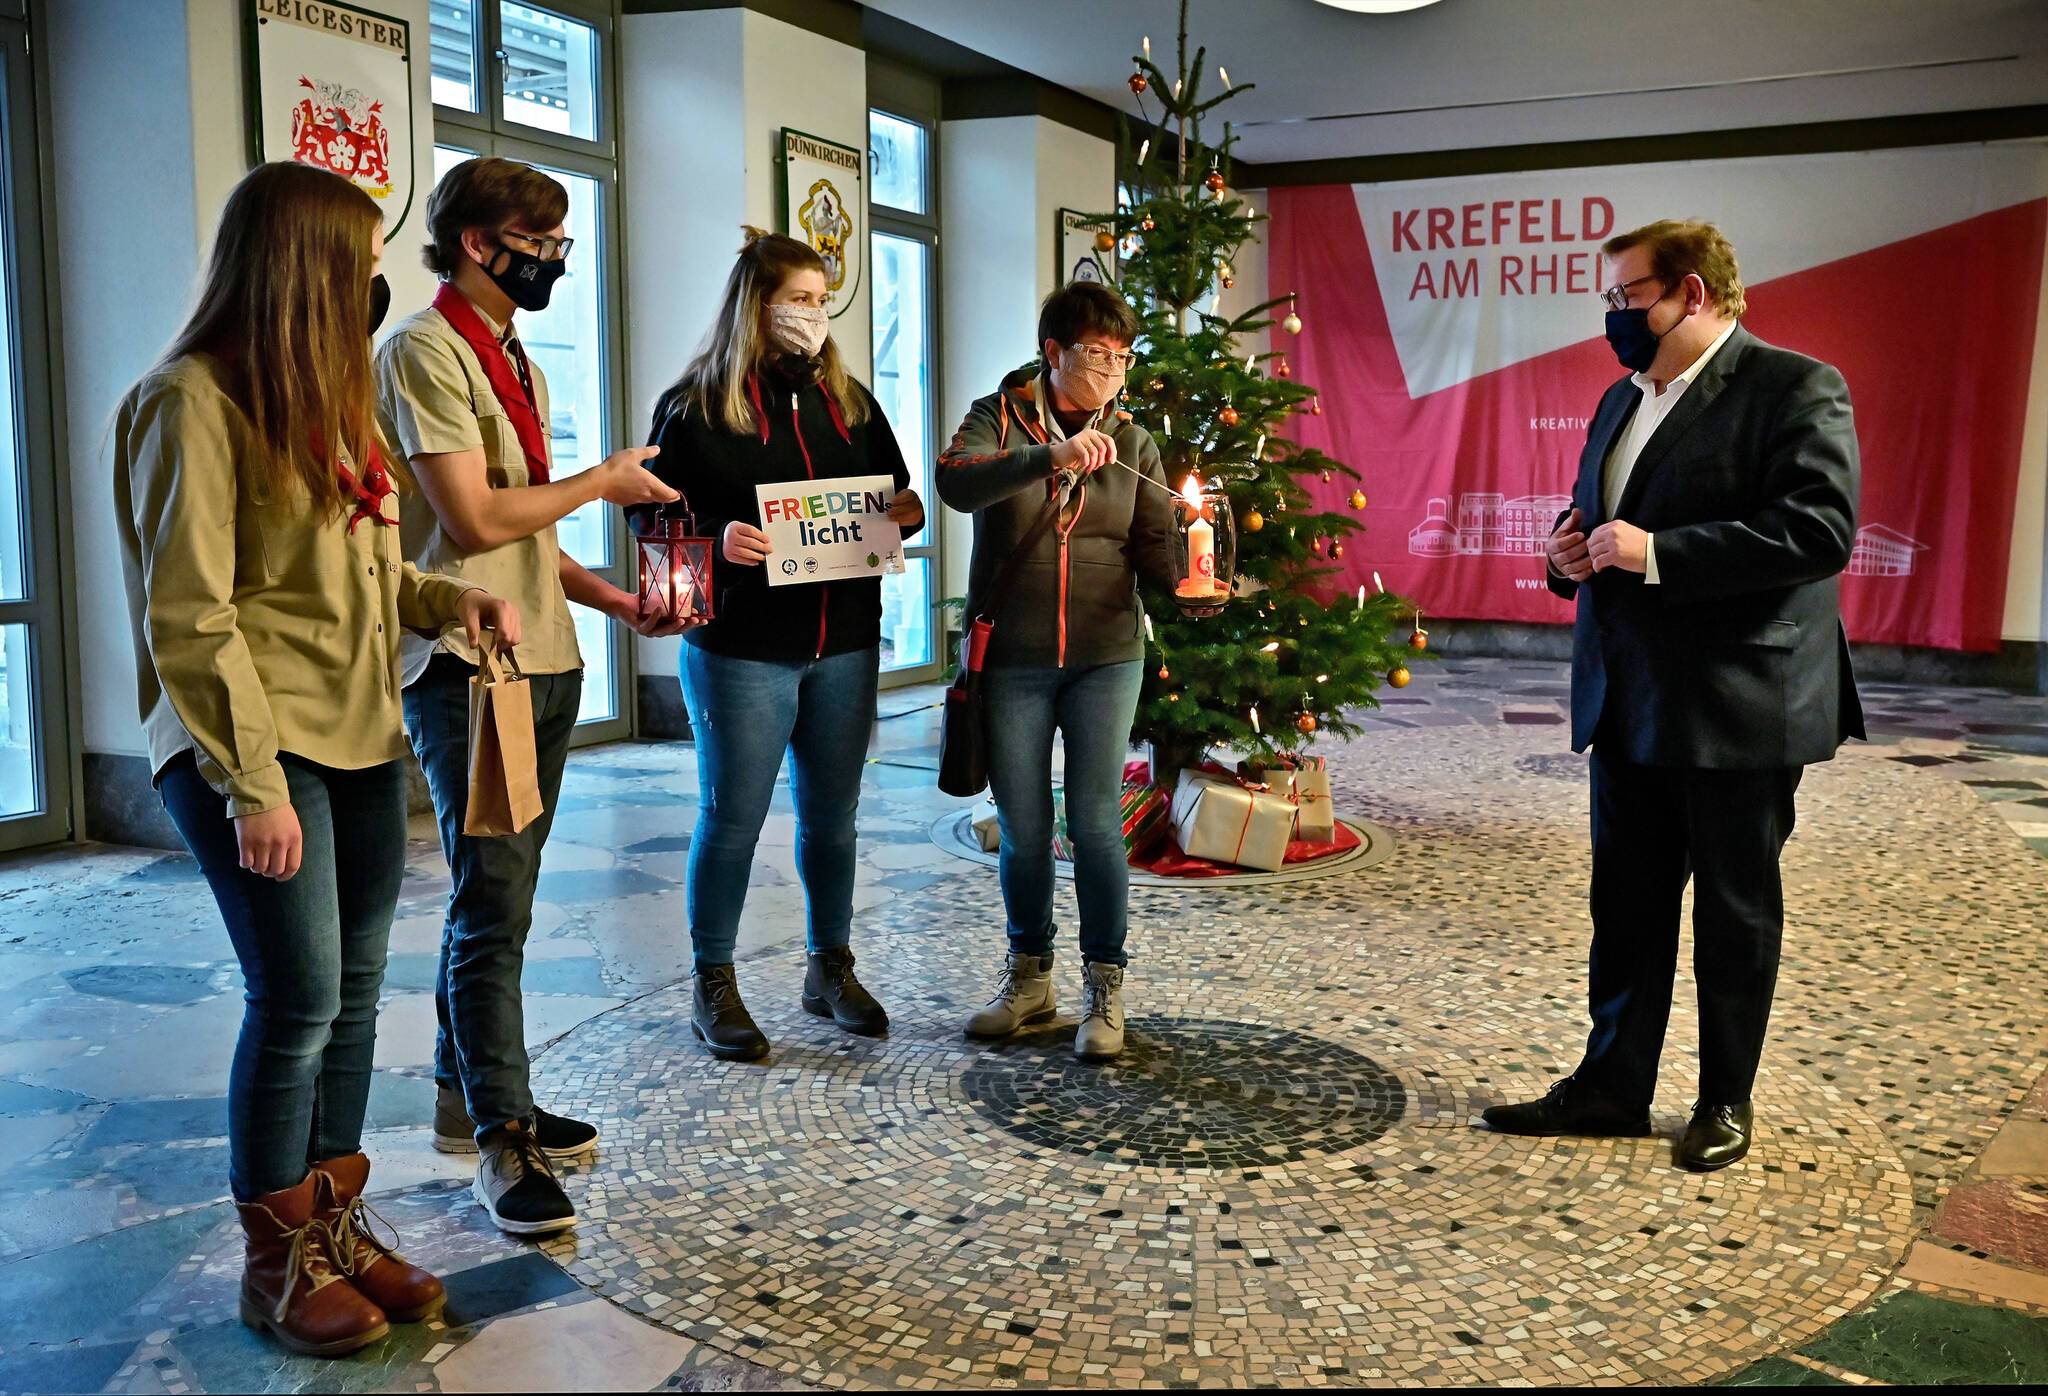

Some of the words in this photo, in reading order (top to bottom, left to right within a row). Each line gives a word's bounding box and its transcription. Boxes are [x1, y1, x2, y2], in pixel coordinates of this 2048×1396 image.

[259, 0, 404, 49] LEICESTER
[787, 135, 860, 171] DÜNKIRCHEN
[1392, 196, 1615, 253] KREFELD
[1409, 258, 1479, 301] AM
[1500, 252, 1602, 297] RHEI
[799, 518, 863, 547] licht
